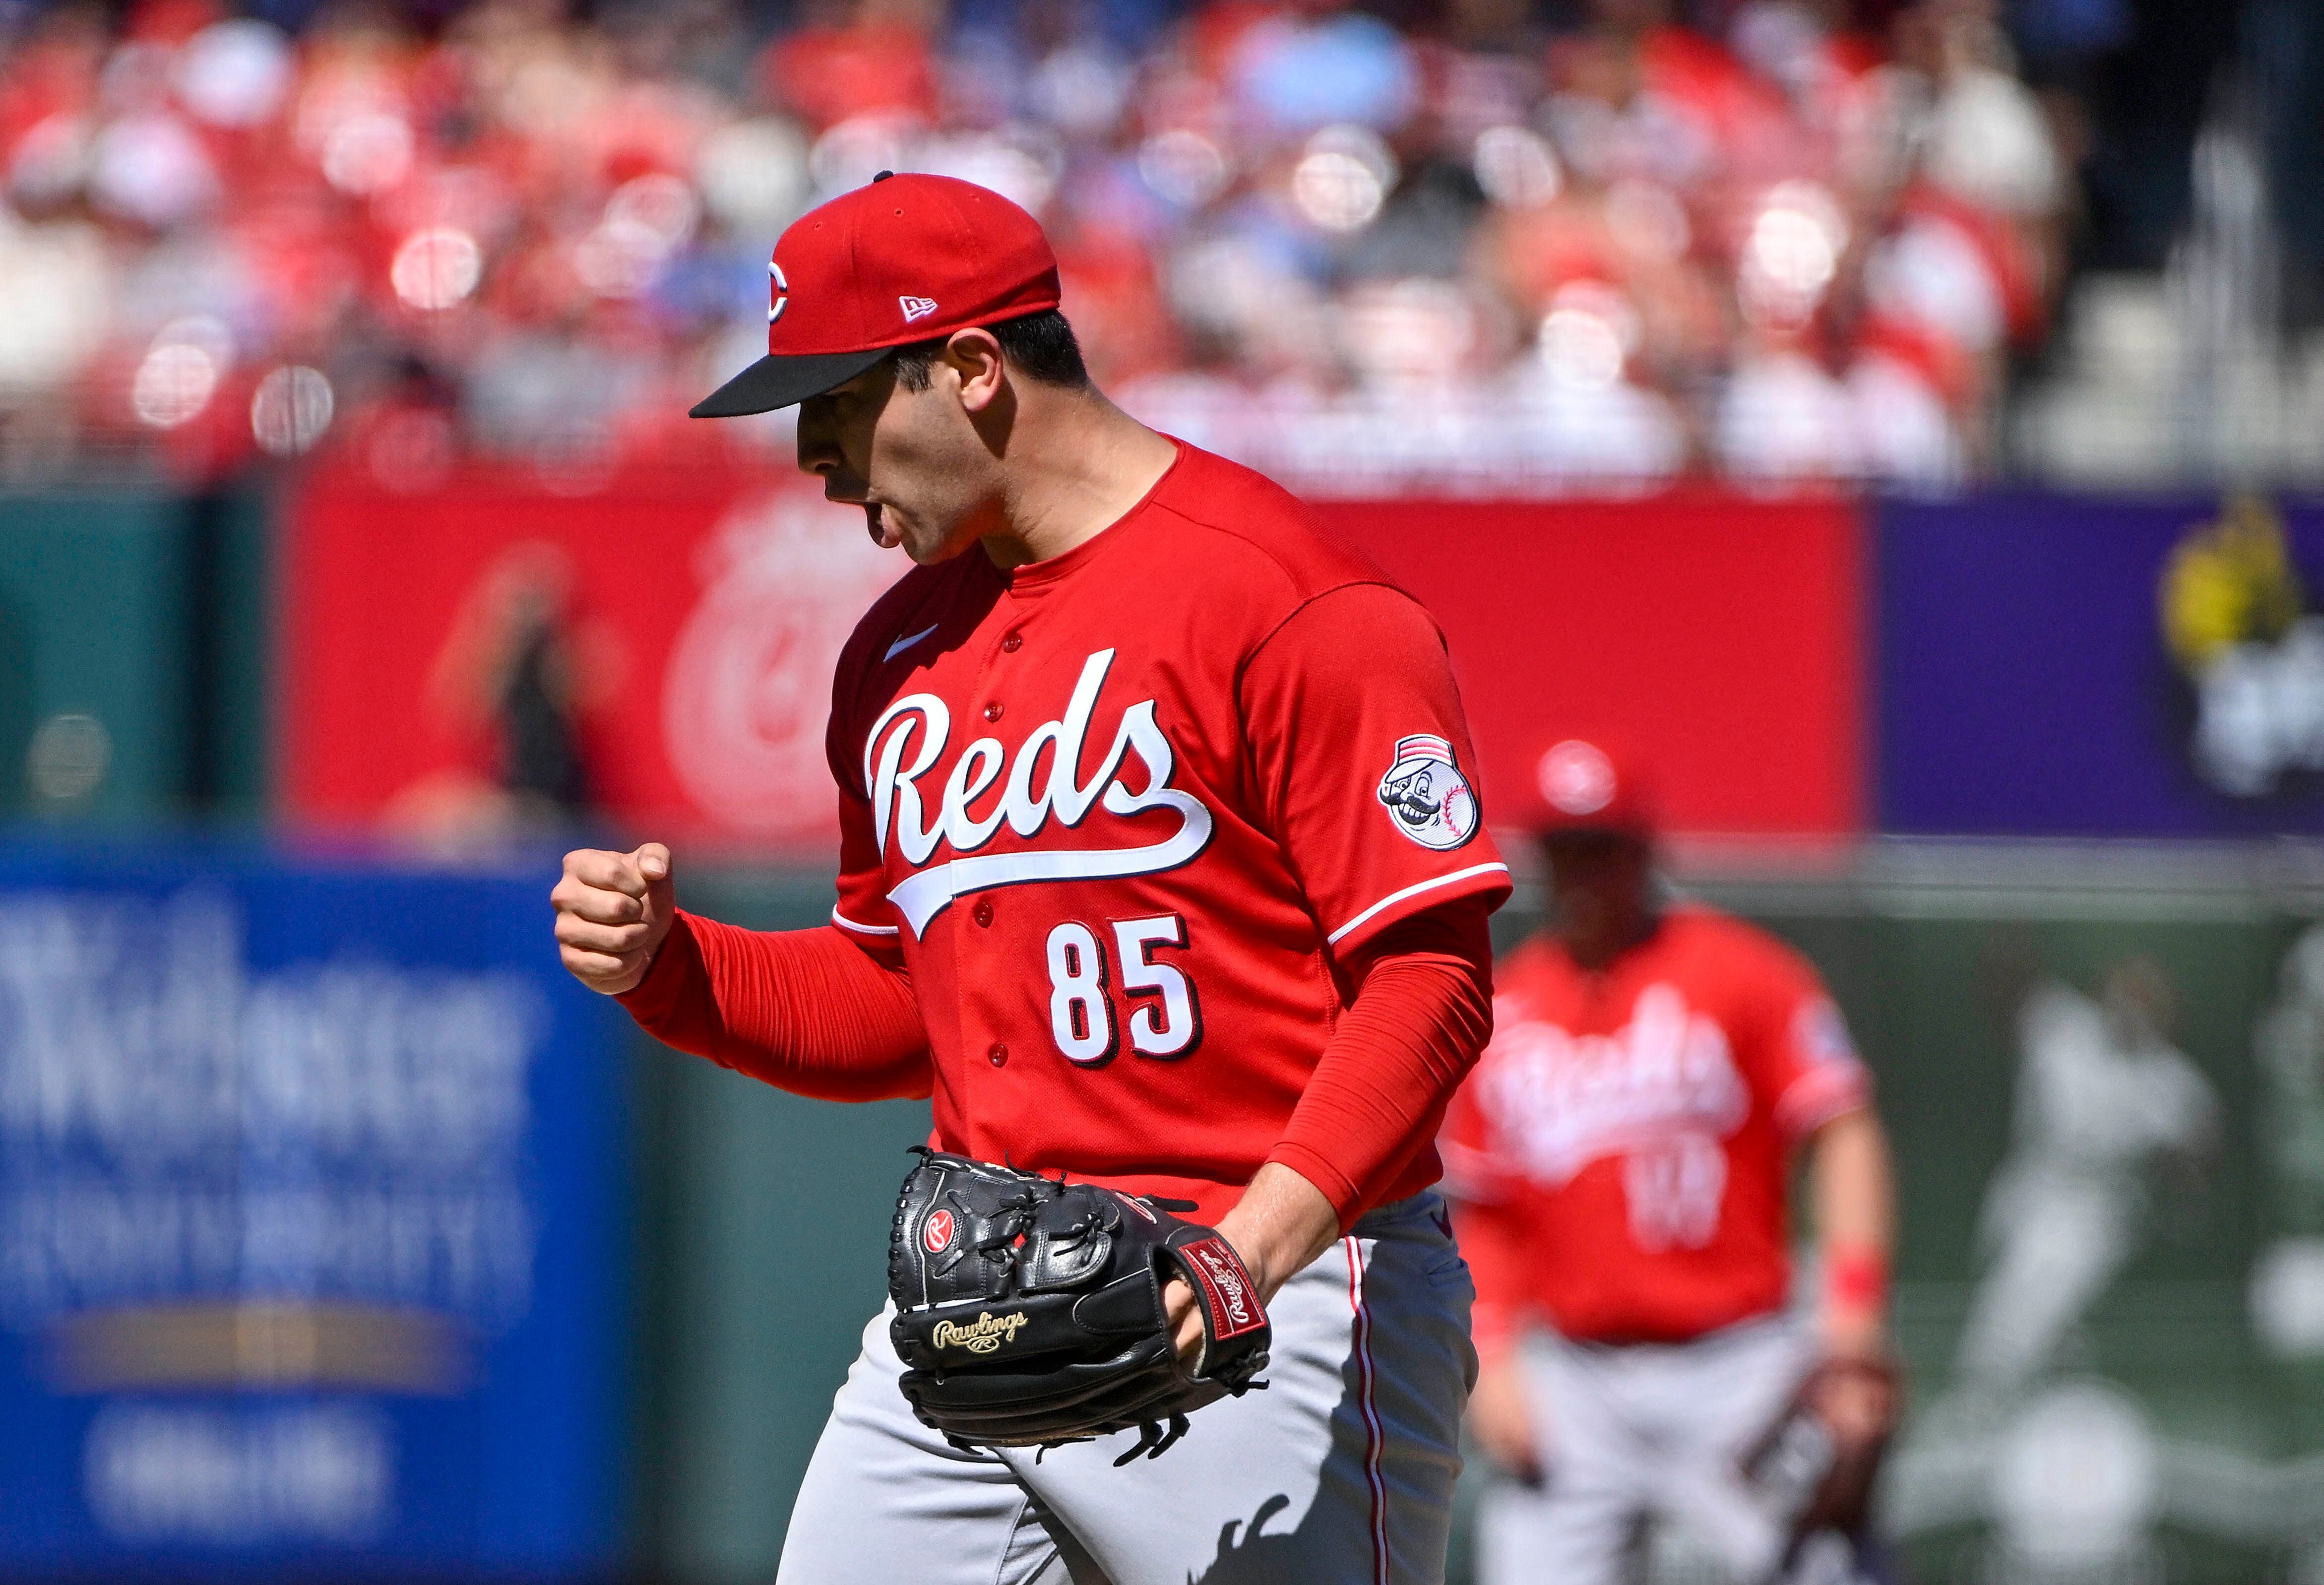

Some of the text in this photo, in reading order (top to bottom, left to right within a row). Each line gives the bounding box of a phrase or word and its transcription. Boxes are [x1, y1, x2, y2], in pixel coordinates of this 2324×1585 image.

[864, 646, 1217, 942] Reds
[1046, 912, 1204, 1068] 85
[933, 1311, 1029, 1349] Rawlings
[1199, 1249, 1249, 1323] Rawlings
